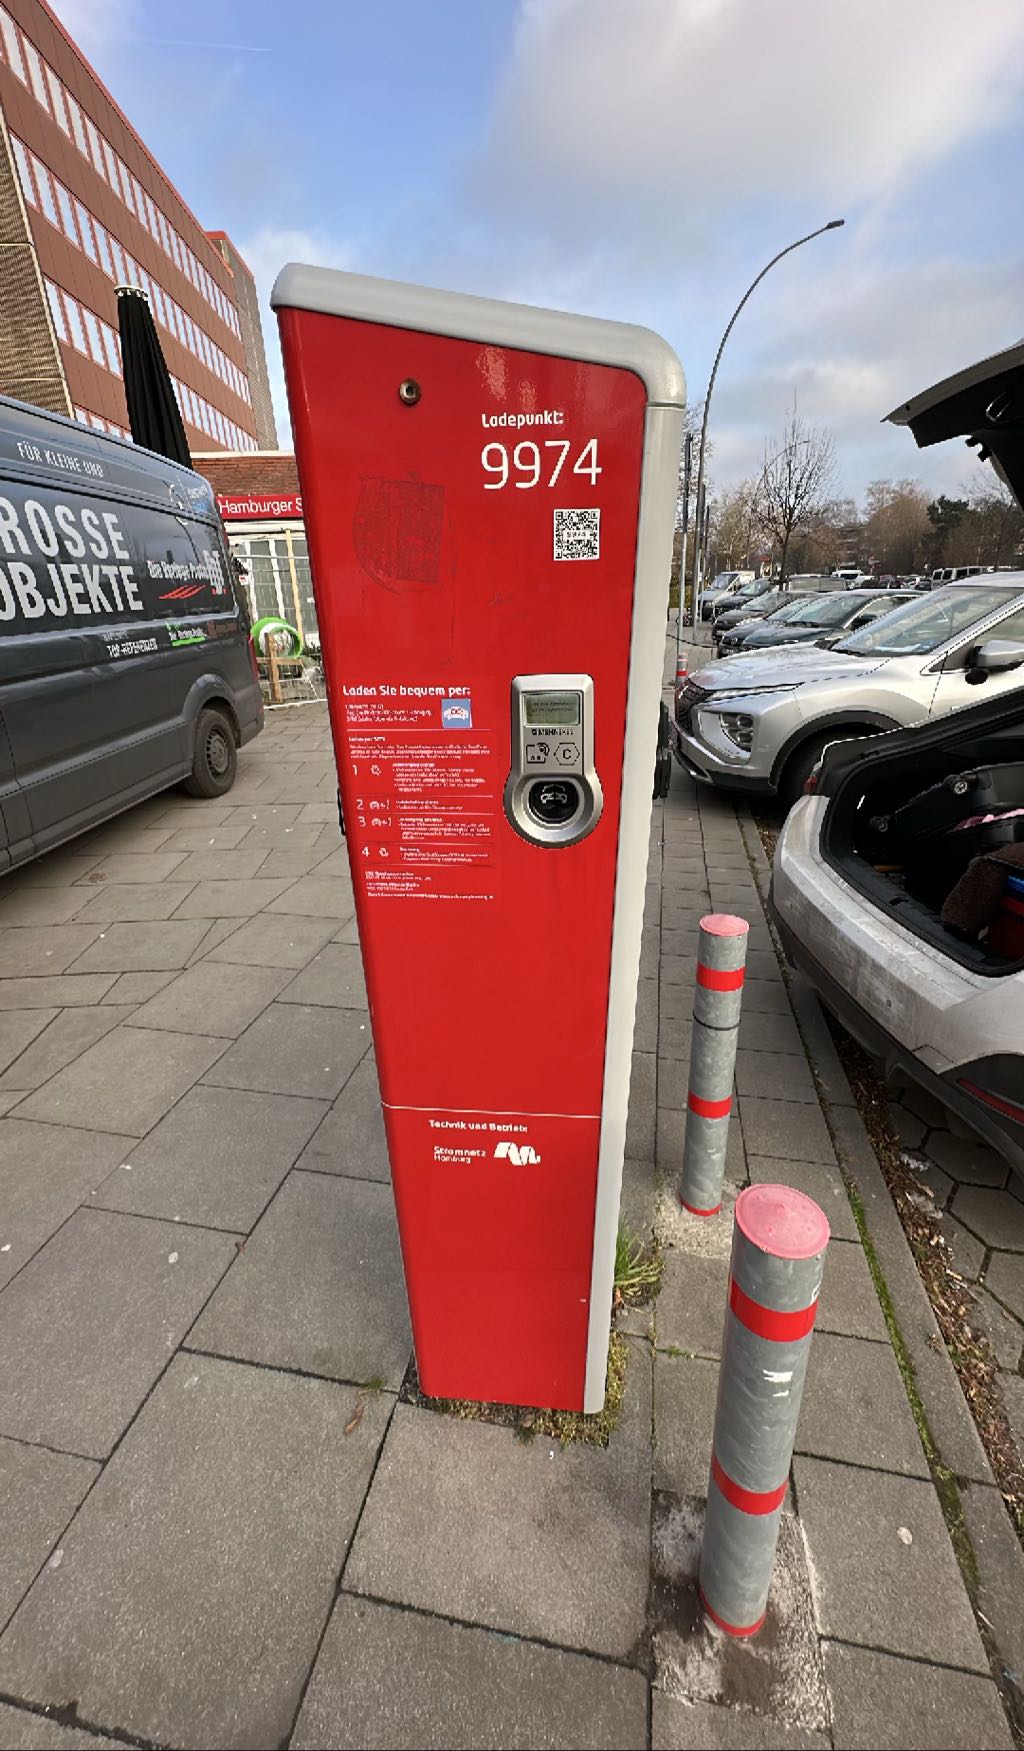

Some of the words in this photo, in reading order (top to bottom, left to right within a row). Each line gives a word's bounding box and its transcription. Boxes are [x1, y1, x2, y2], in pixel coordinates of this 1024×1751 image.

[482, 410, 564, 429] Ladepunkt:
[17, 440, 42, 462] FÜR
[44, 449, 82, 472] KLEINE
[82, 460, 104, 478] UND
[481, 438, 603, 489] 9974
[218, 499, 293, 515] Hamburger
[342, 685, 377, 696] Laden
[379, 685, 397, 696] Sie
[399, 685, 445, 698] bequem
[448, 687, 471, 698] per:
[352, 765, 358, 775] 1
[356, 799, 364, 810] 2
[358, 816, 366, 827] 3
[361, 846, 370, 857] 4
[429, 1119, 466, 1130] Technik
[468, 1122, 487, 1131] und
[433, 1146, 486, 1157] Stromnetz
